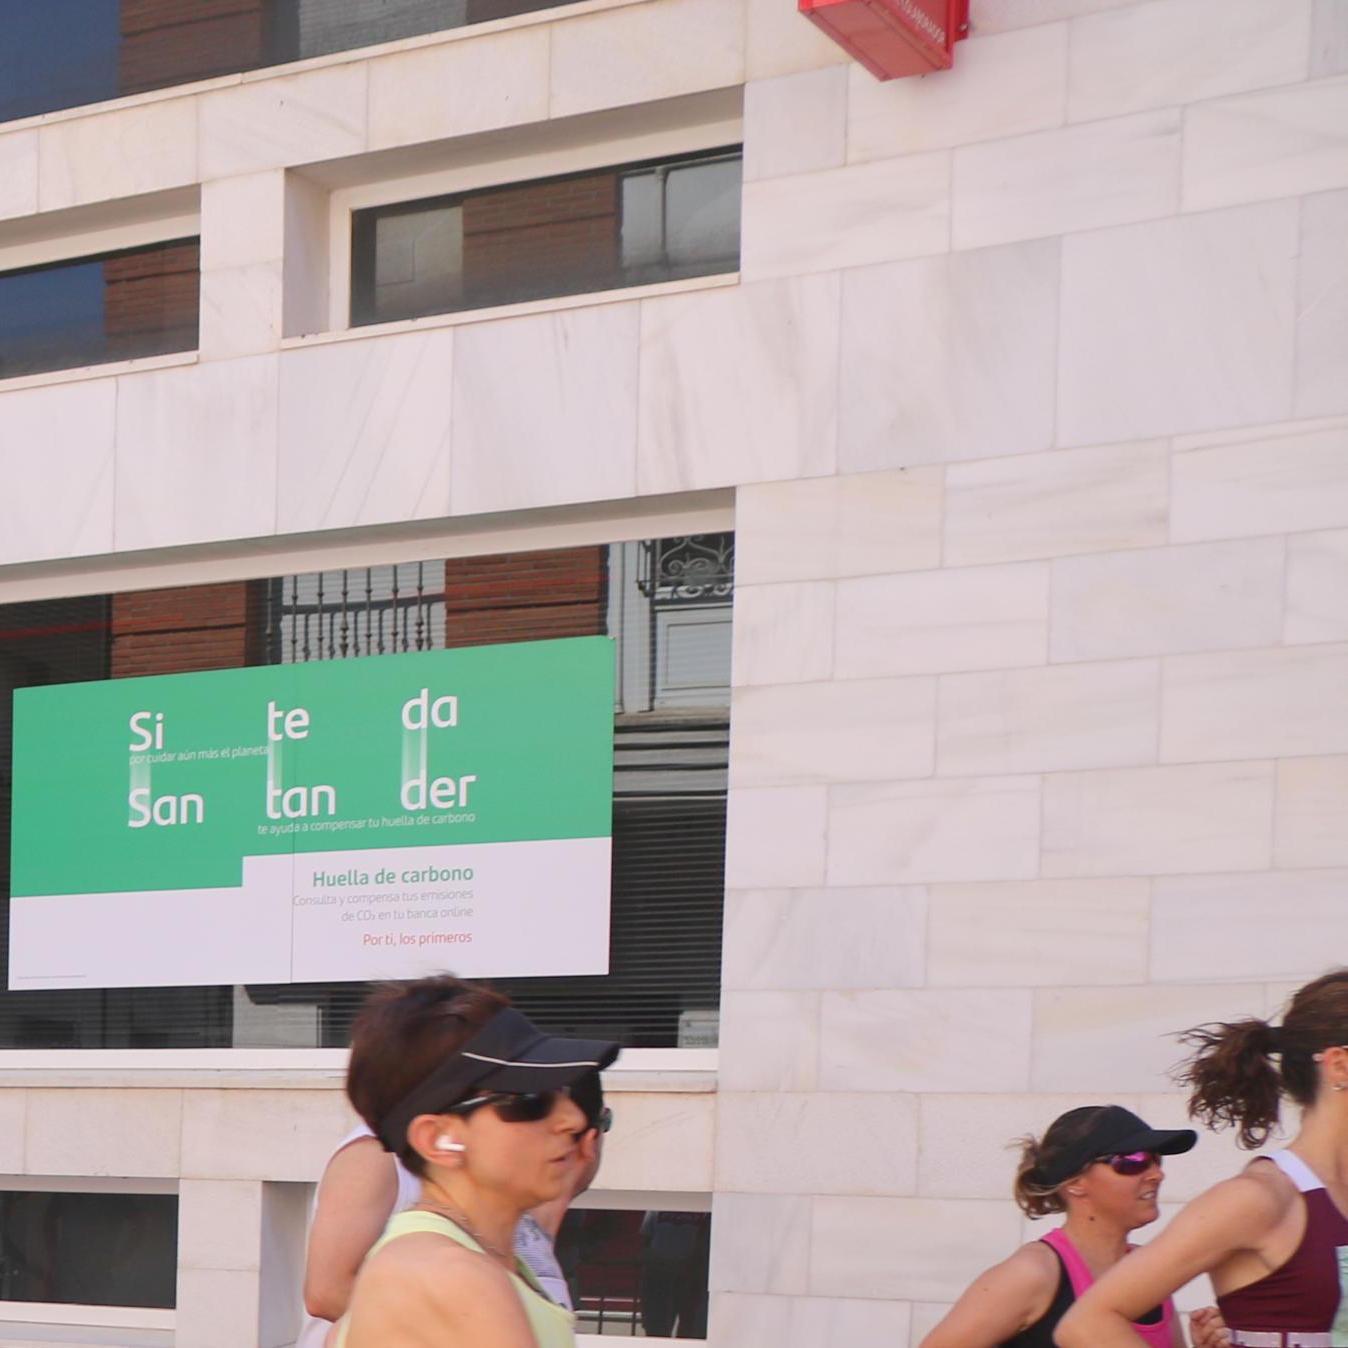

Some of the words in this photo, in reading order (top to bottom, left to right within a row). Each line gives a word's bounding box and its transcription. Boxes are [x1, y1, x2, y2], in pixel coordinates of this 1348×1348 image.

[129, 711, 164, 752] Si
[267, 700, 310, 741] te
[401, 688, 458, 730] da
[147, 750, 176, 764] cuidar
[198, 747, 218, 760] más
[221, 746, 230, 759] el
[232, 744, 268, 759] planeta
[128, 788, 204, 828] San
[266, 780, 336, 819] tan
[400, 769, 477, 811] der
[258, 825, 268, 834] te
[270, 823, 300, 837] ayuda
[303, 824, 309, 832] a
[310, 819, 365, 833] compensar
[369, 819, 379, 829] tu
[381, 816, 414, 828] huella
[417, 815, 429, 826] de
[432, 813, 475, 825] carbono
[313, 870, 369, 887] Huella
[374, 869, 396, 885] de
[401, 865, 474, 883] carbono
[347, 893, 400, 906] compensa
[402, 892, 418, 902] tus
[421, 890, 473, 901] emisiones
[341, 910, 354, 921] de
[378, 912, 391, 920] en
[394, 910, 405, 920] tu
[407, 908, 438, 919] banca
[440, 907, 473, 918] online
[363, 933, 382, 946] Por
[399, 932, 416, 945] los
[419, 931, 472, 947] primeros
